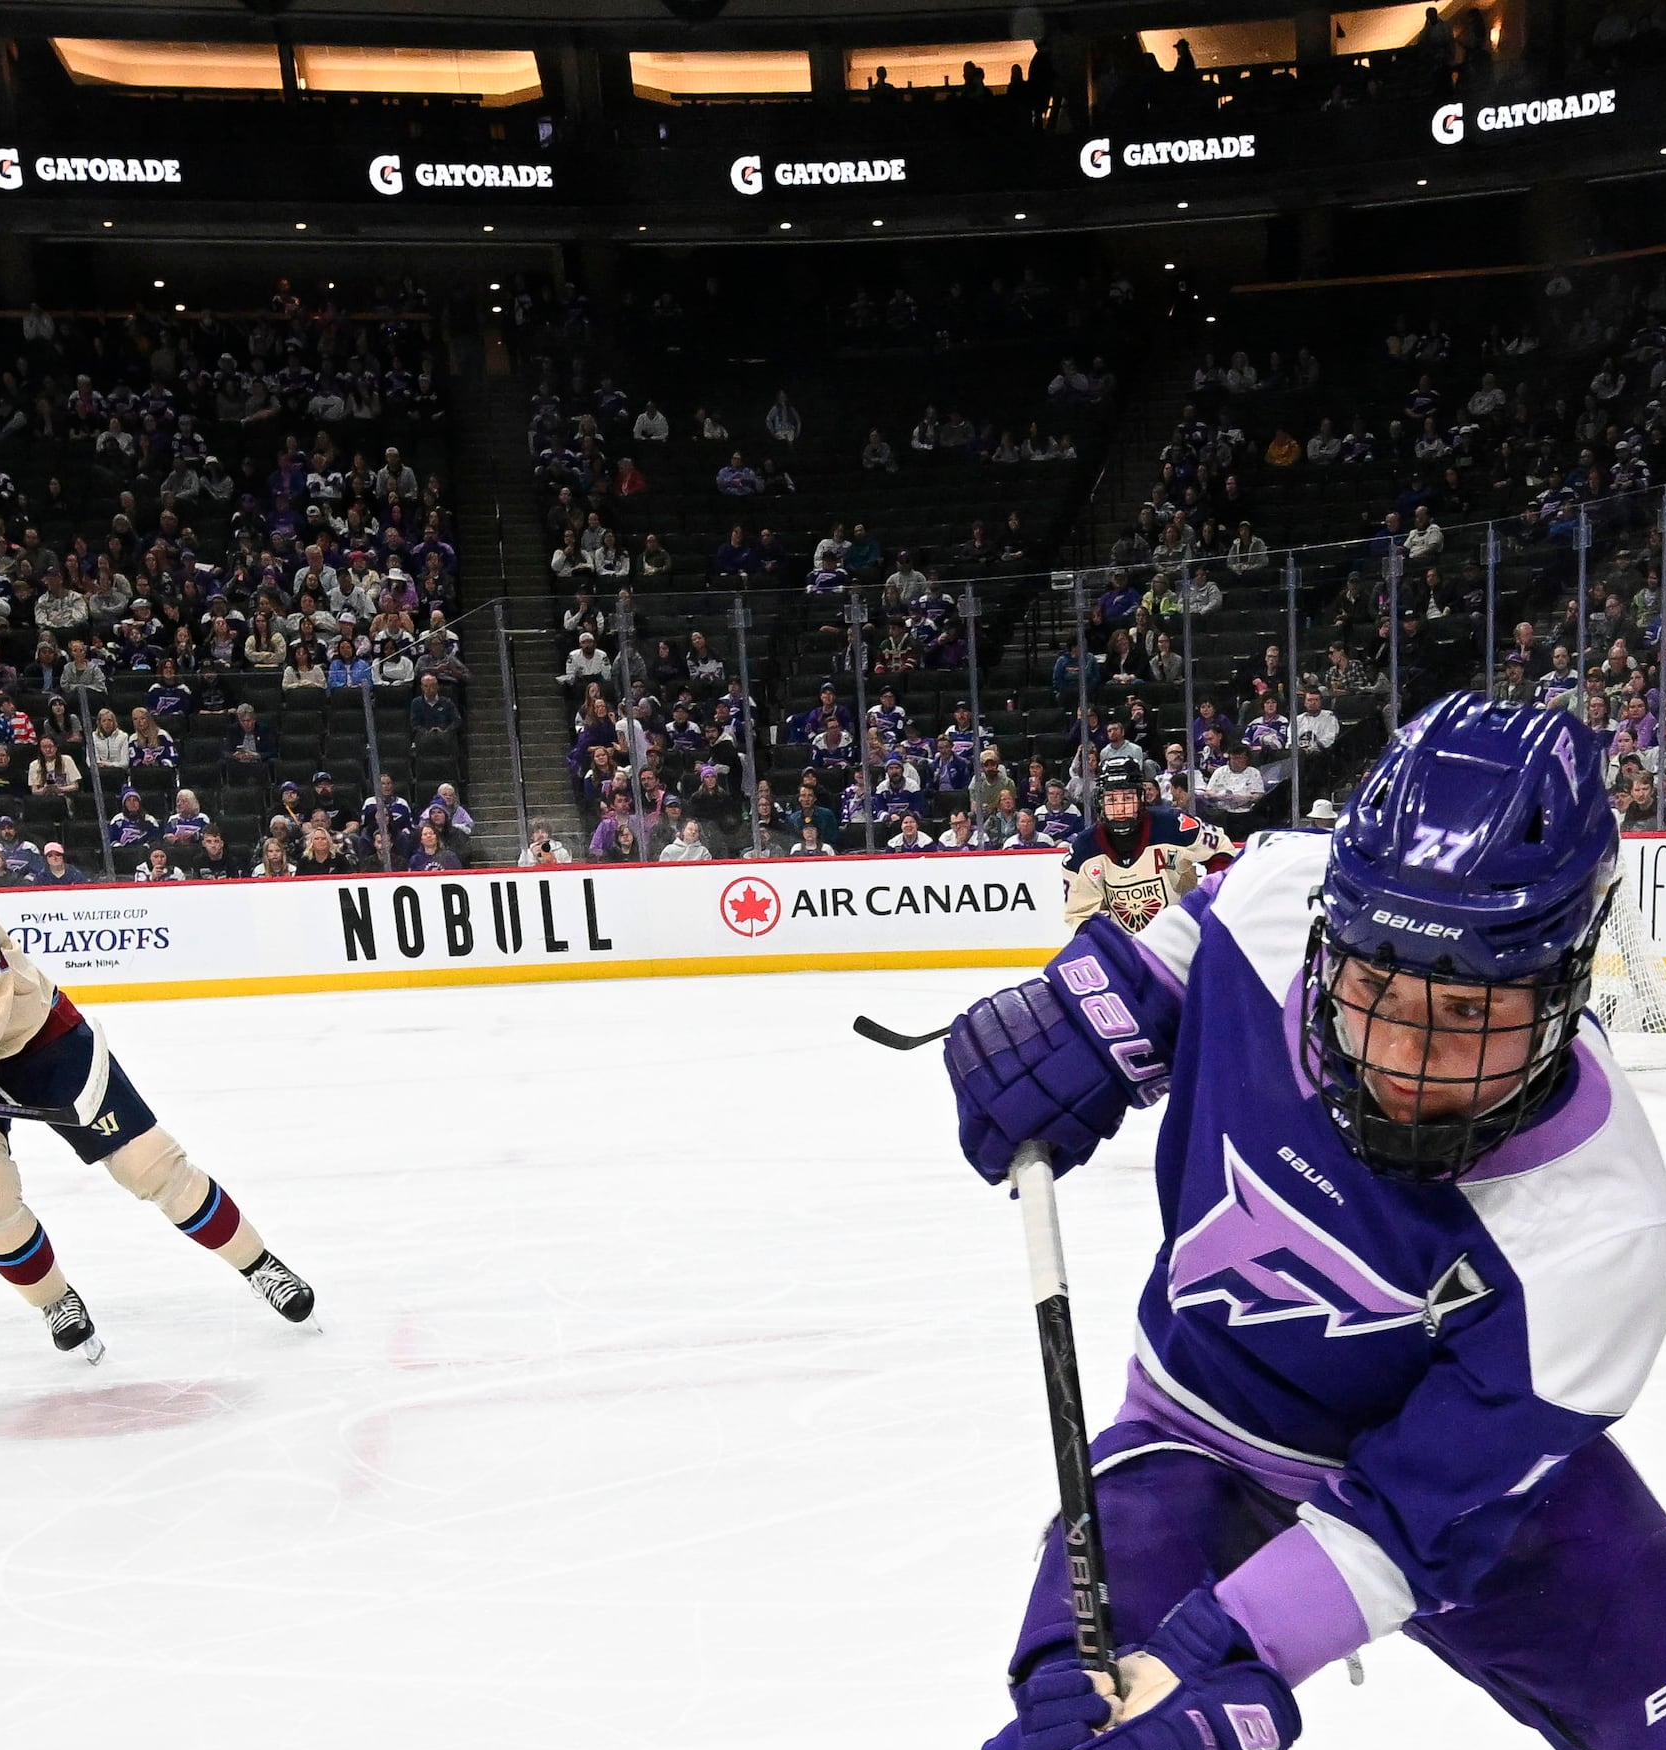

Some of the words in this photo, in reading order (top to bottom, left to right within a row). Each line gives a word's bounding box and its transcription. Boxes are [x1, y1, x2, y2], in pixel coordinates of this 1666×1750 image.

[1476, 89, 1616, 132] GATORADE
[1123, 134, 1256, 167] GATORADE
[35, 156, 182, 183] GATORADE
[415, 163, 554, 188] GATORADE
[774, 158, 907, 186] GATORADE
[1153, 848, 1166, 875] A
[1403, 822, 1474, 873] 77
[72, 909, 121, 921] WALTER
[123, 908, 148, 919] CUP
[791, 887, 858, 918] AIR
[865, 882, 1037, 916] CANADA
[338, 877, 613, 962] NOBULL
[1371, 908, 1464, 941] BAUER
[7, 927, 170, 954] PLAYOFFS
[1277, 1145, 1345, 1207] BAUER
